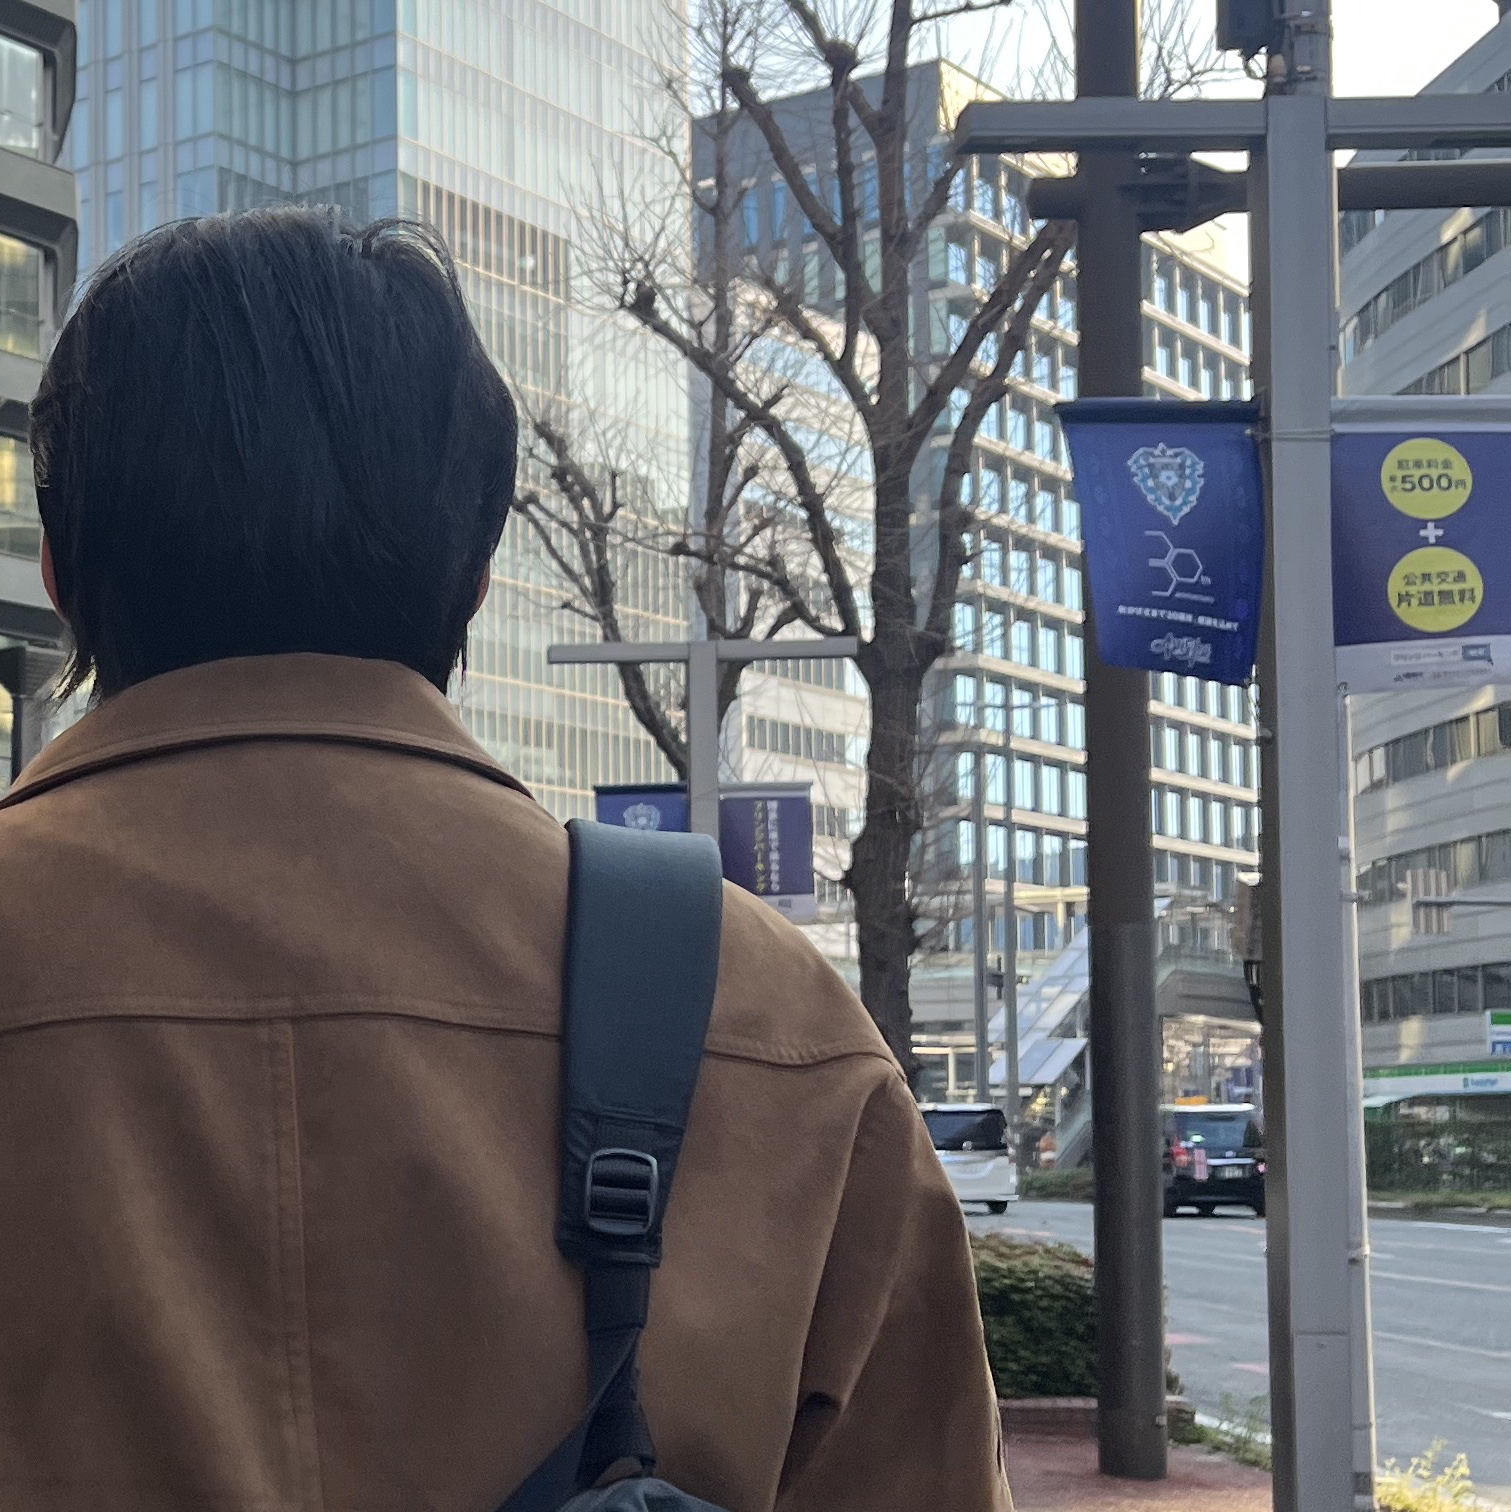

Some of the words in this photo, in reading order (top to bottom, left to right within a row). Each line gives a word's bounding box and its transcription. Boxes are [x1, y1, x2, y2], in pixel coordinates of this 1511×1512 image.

[1403, 570, 1467, 586] 公共交通
[1396, 587, 1476, 608] 片道無料
